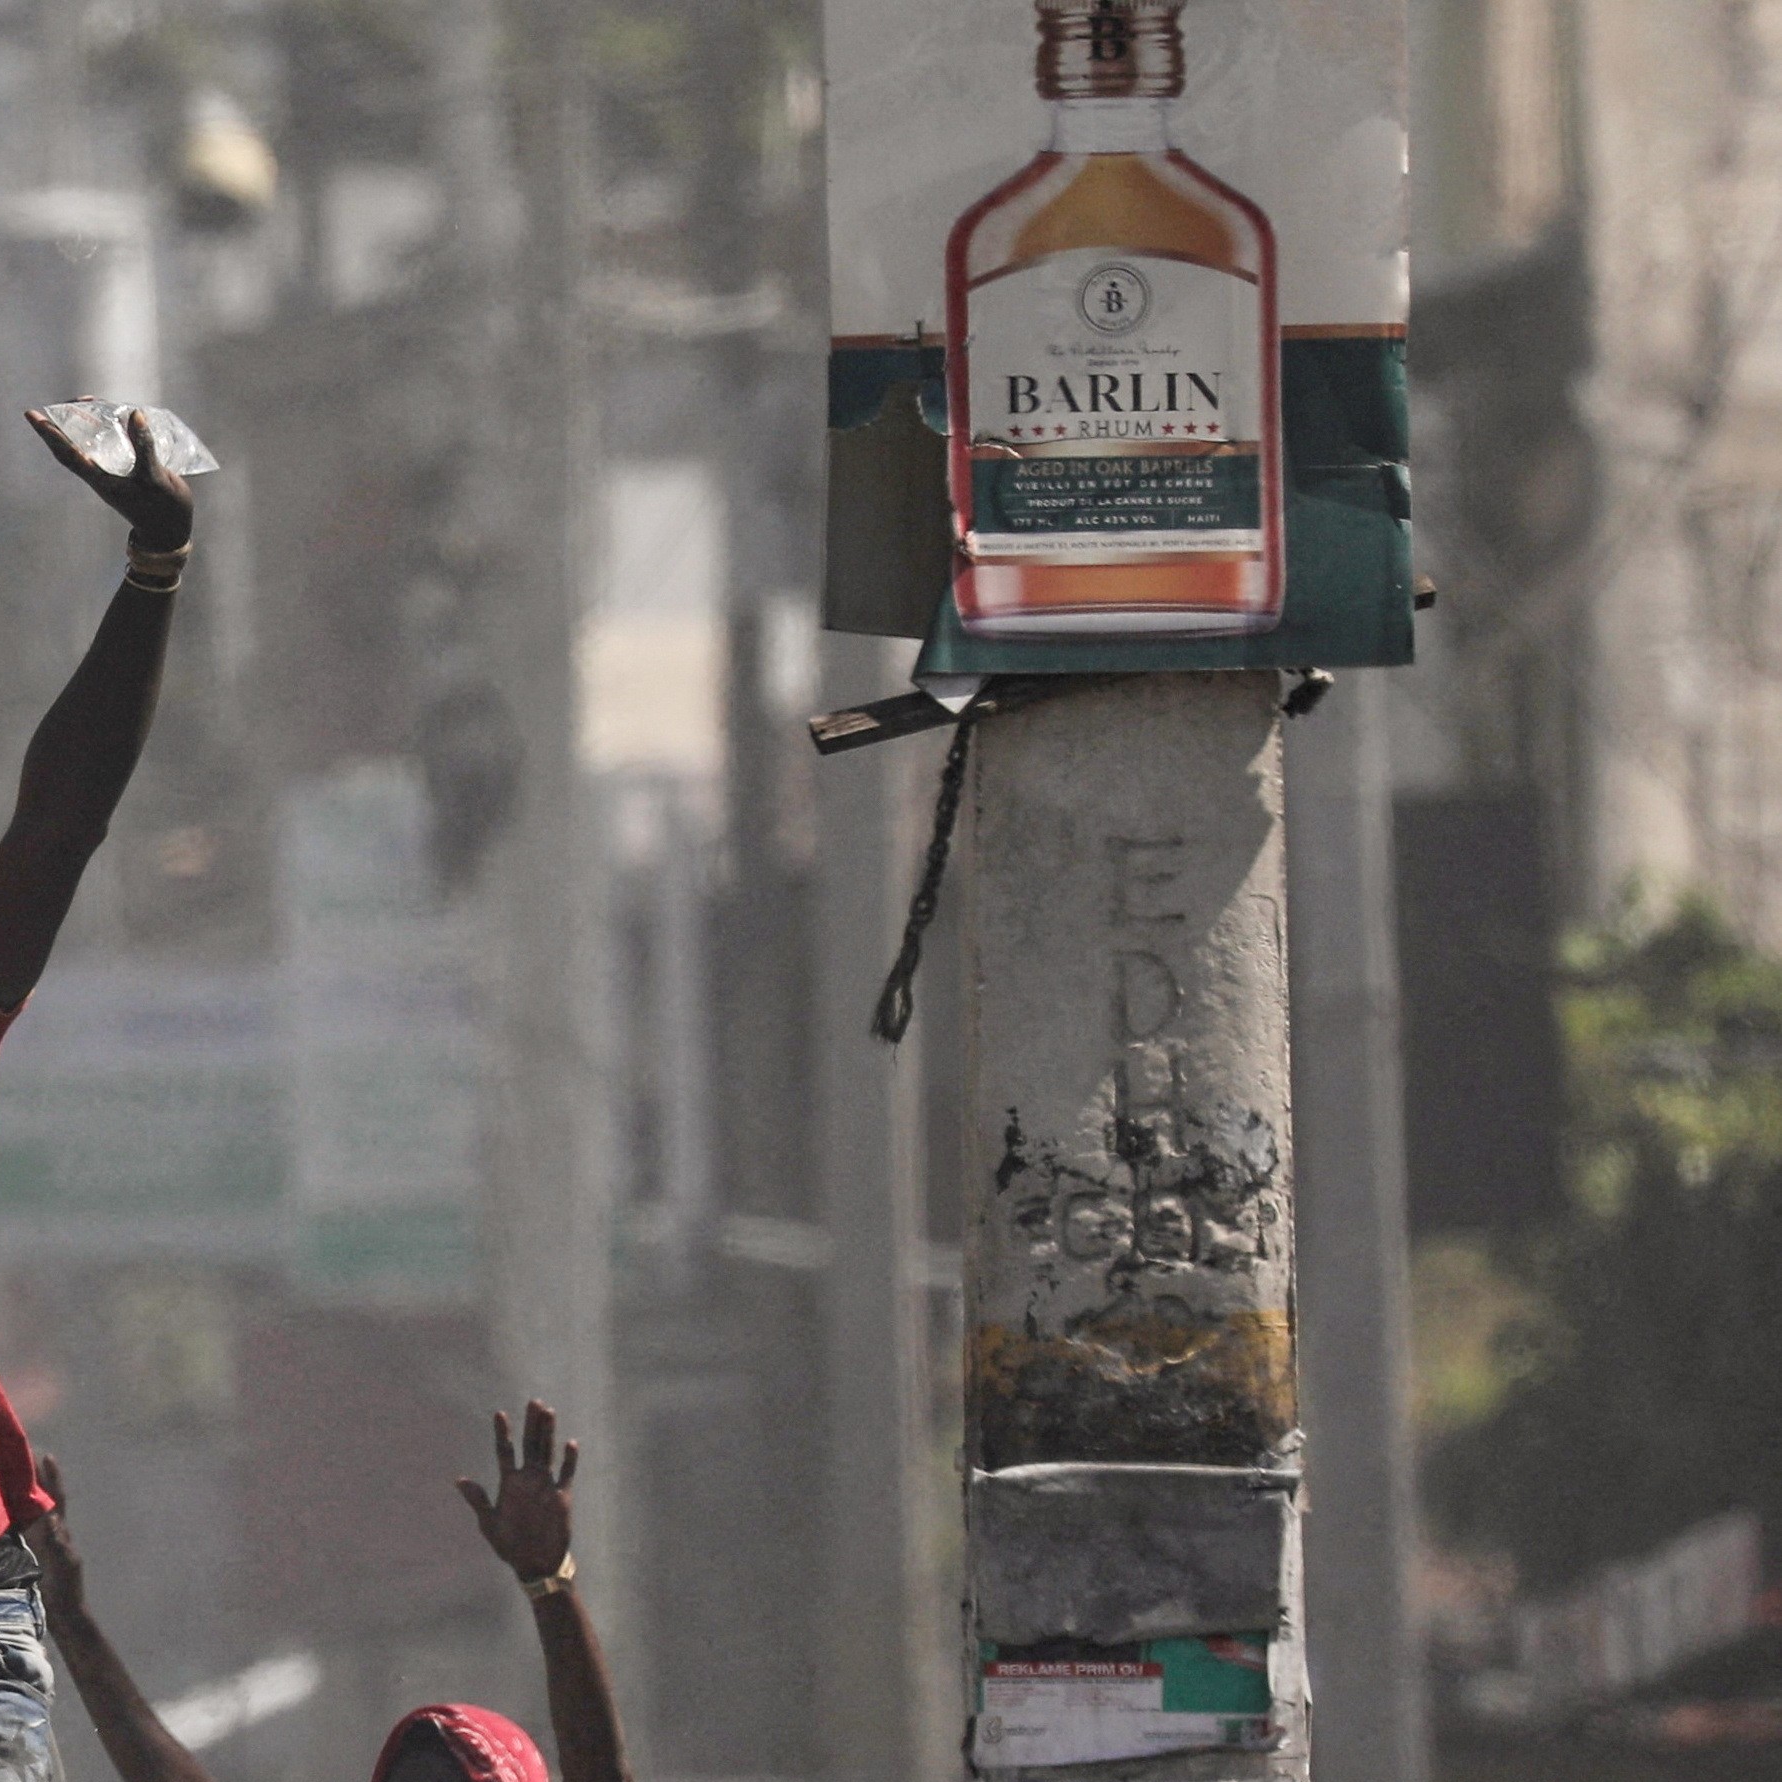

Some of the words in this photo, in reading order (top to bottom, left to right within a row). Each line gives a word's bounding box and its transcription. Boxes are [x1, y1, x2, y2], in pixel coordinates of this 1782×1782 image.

[1007, 372, 1221, 414] BARLIN
[1079, 420, 1153, 438] RHUM
[1017, 461, 1065, 476] AGED
[1070, 461, 1090, 475] IN
[1096, 460, 1133, 475] OAK
[1140, 460, 1214, 475] BARRELS
[1074, 516, 1100, 525] ALC
[1131, 514, 1157, 524] VOL
[998, 1663, 1071, 1676] REKLAME
[1075, 1663, 1116, 1676] PRIM
[1120, 1663, 1144, 1676] OU
